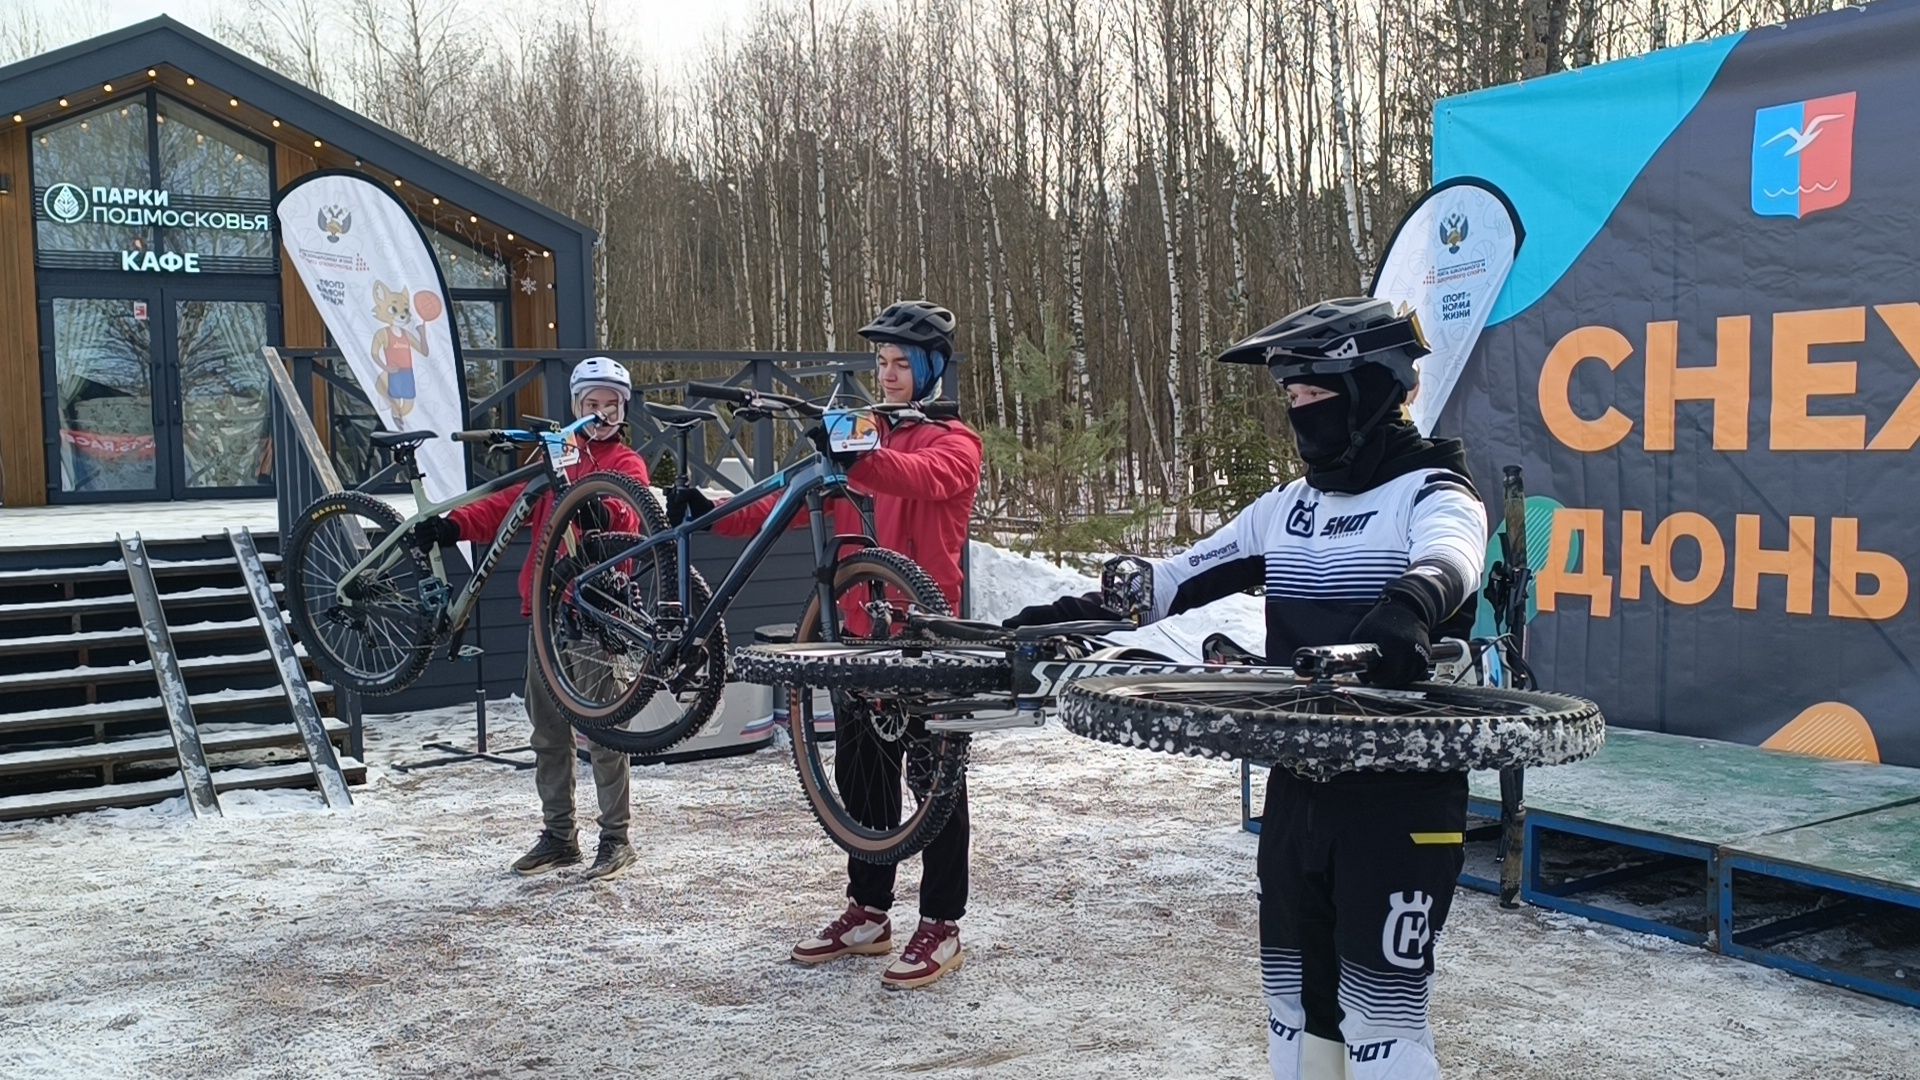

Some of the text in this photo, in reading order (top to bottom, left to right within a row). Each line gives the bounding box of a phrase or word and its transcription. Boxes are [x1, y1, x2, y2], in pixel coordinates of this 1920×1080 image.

[92, 186, 168, 208] ПАРКИ
[92, 206, 270, 232] ПОДМОСКОВЬЯ
[121, 250, 201, 274] КАФЕ
[1442, 309, 1470, 321] ЖИЗНИ
[1320, 510, 1379, 537] SHOT
[1197, 540, 1238, 562] Husqvarna
[1536, 508, 1909, 620] ДЮНЬ
[1346, 1039, 1397, 1062] HOT
